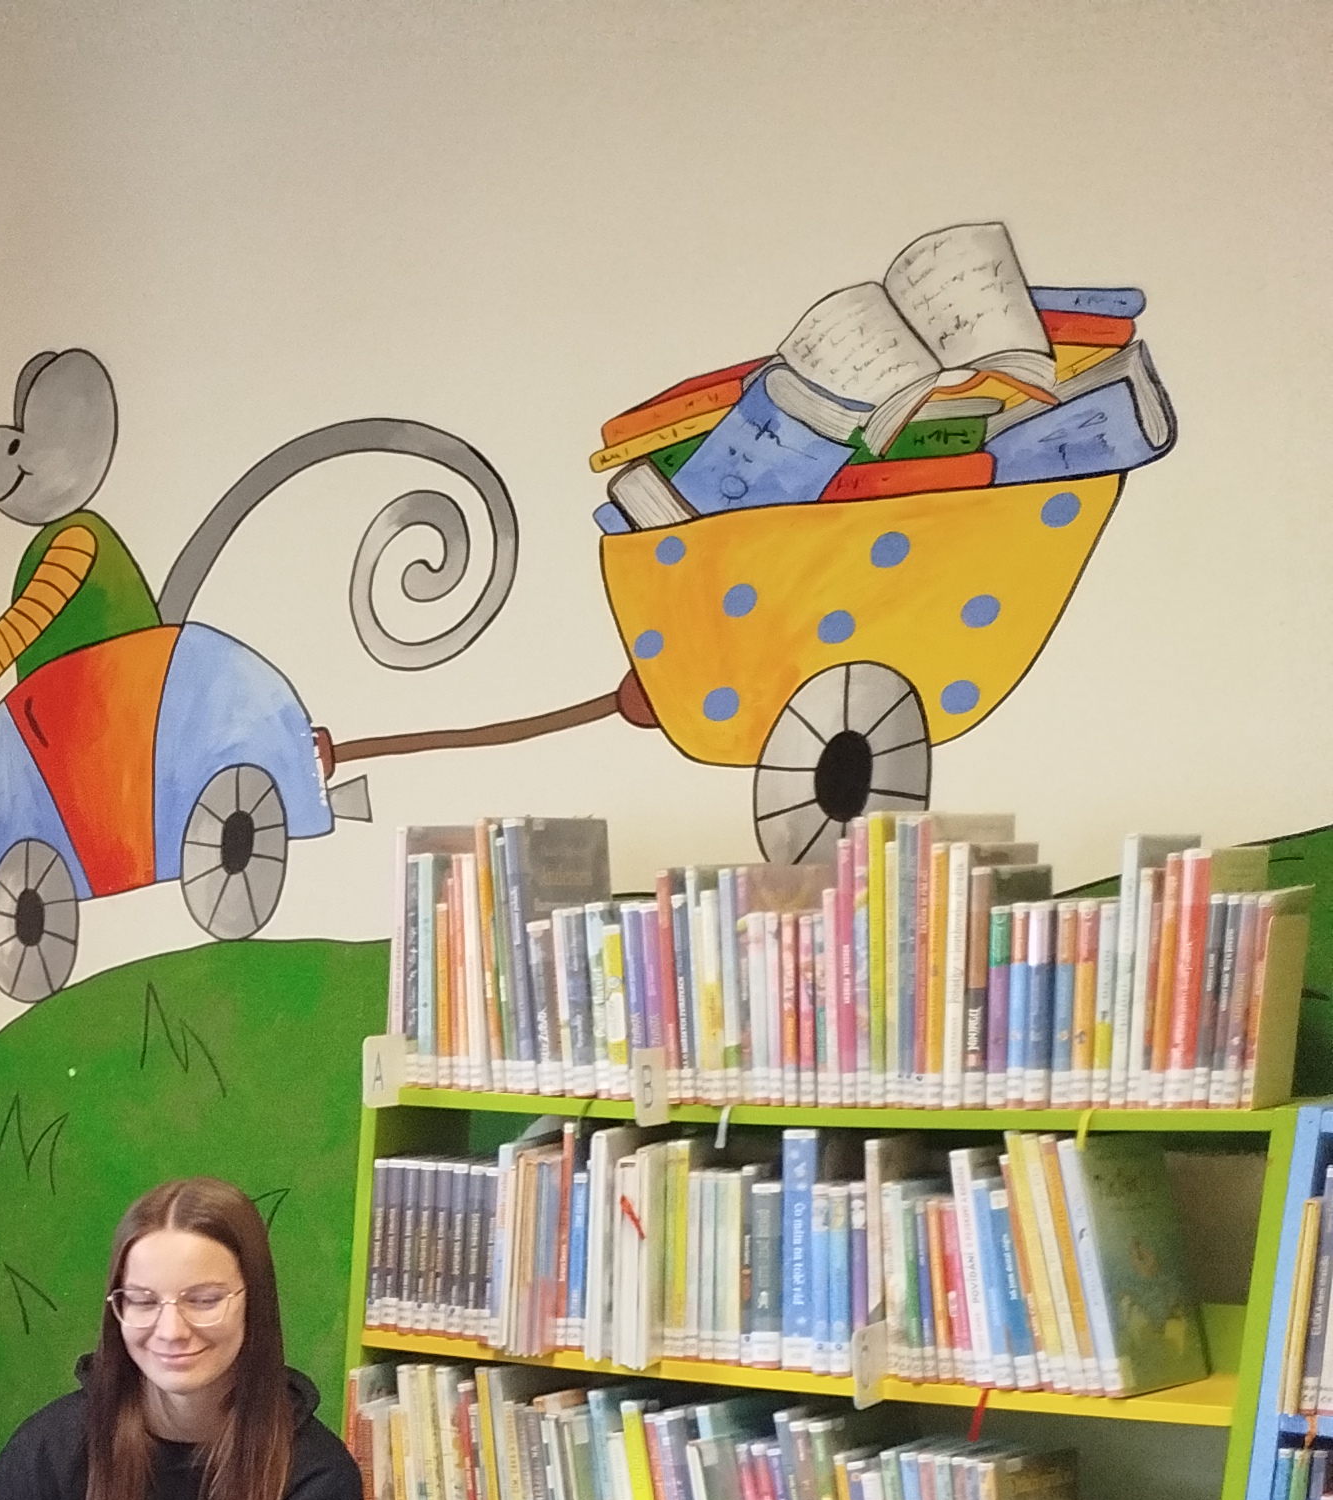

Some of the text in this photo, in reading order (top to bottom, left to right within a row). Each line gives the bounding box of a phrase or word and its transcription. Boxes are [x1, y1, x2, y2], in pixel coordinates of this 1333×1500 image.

[372, 1051, 384, 1091] A
[642, 1064, 654, 1109] B
[792, 1263, 806, 1285] tobě
[966, 1252, 981, 1304] POVÍDÁNÍ
